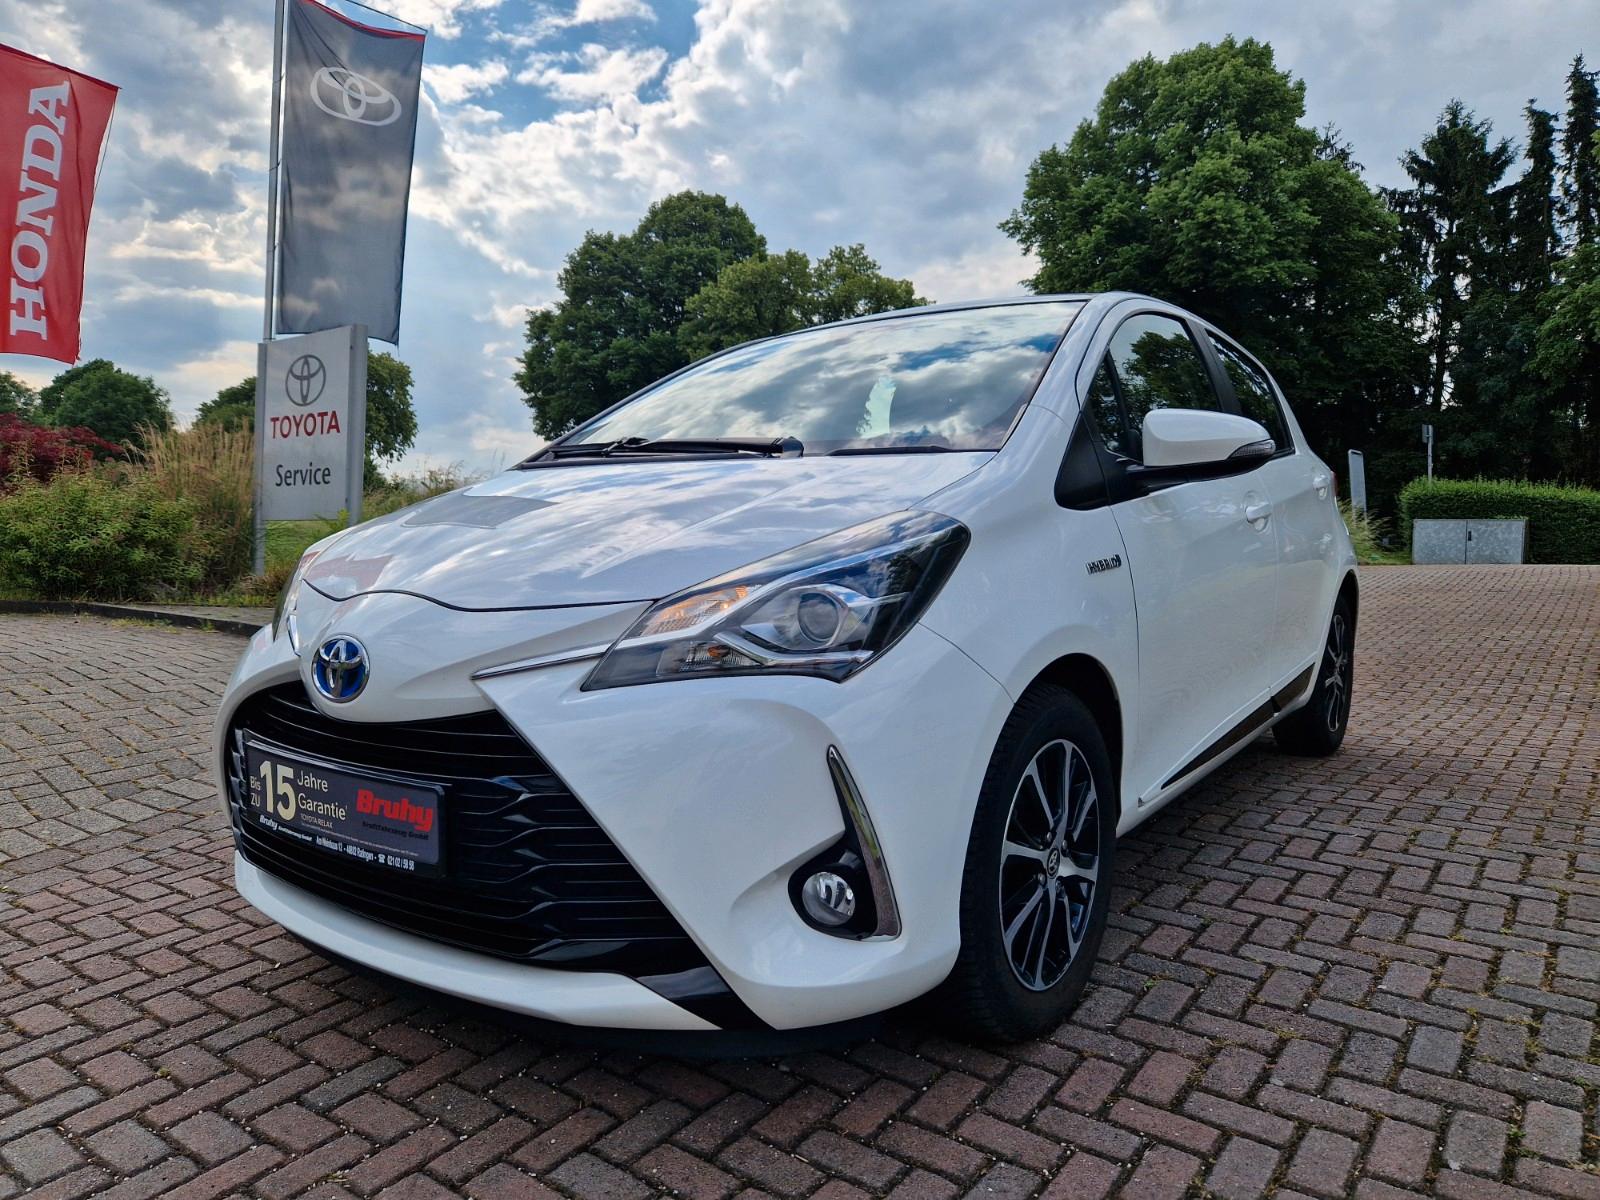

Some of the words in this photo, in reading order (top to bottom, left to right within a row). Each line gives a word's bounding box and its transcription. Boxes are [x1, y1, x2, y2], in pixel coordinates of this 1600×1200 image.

[9, 80, 71, 340] HONDA
[270, 410, 341, 439] TOYOTA
[275, 461, 331, 487] Service
[260, 760, 297, 821] 15
[297, 770, 328, 792] Jahre
[356, 789, 432, 832] Bruhy
